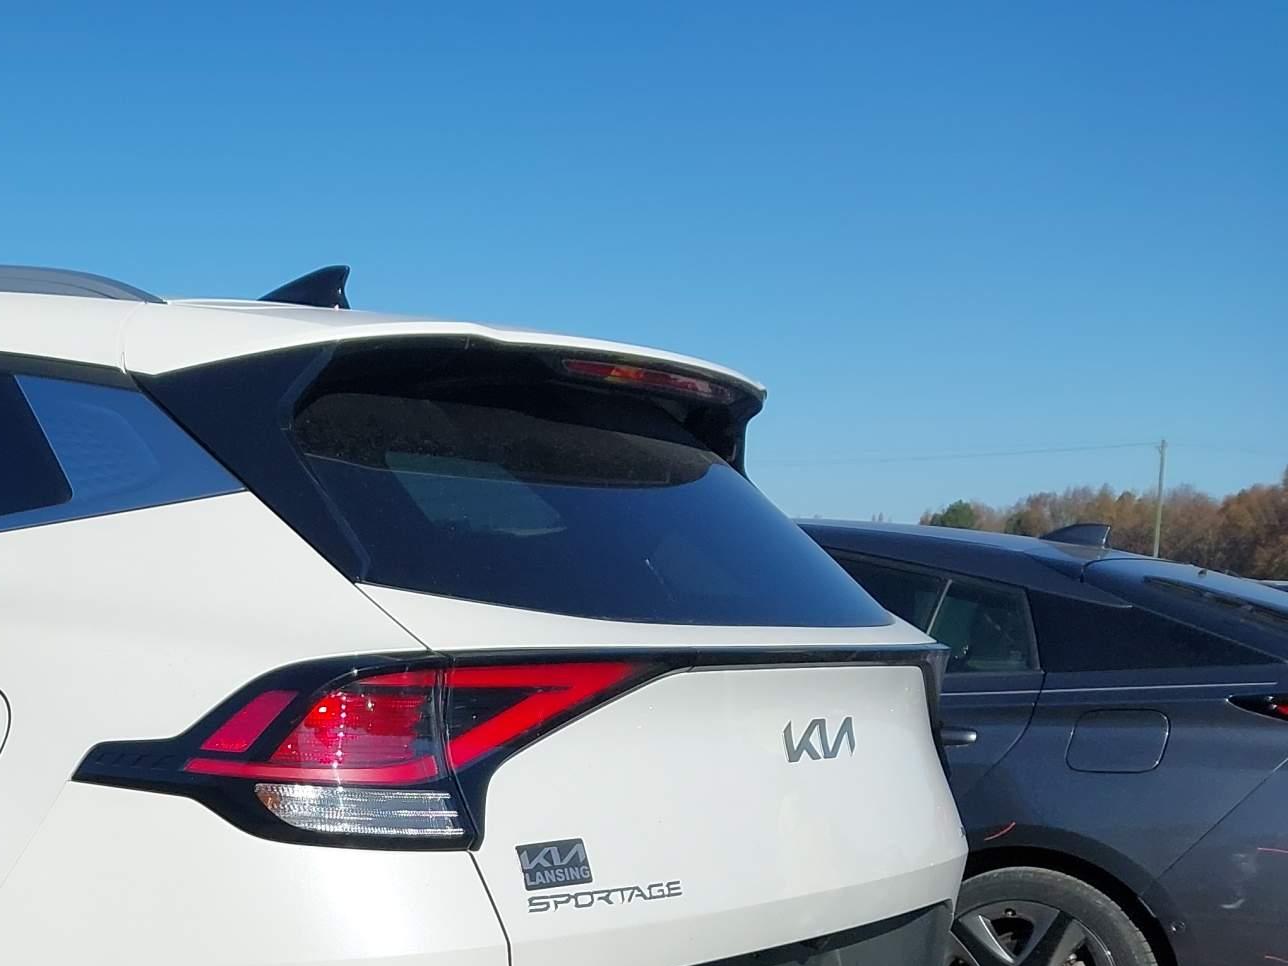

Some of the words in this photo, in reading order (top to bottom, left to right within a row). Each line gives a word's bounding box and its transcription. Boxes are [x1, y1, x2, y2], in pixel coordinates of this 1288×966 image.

[783, 716, 856, 763] KIA
[520, 843, 586, 870] KIA
[525, 865, 590, 886] LANSING
[528, 880, 683, 913] SPORTAGE
